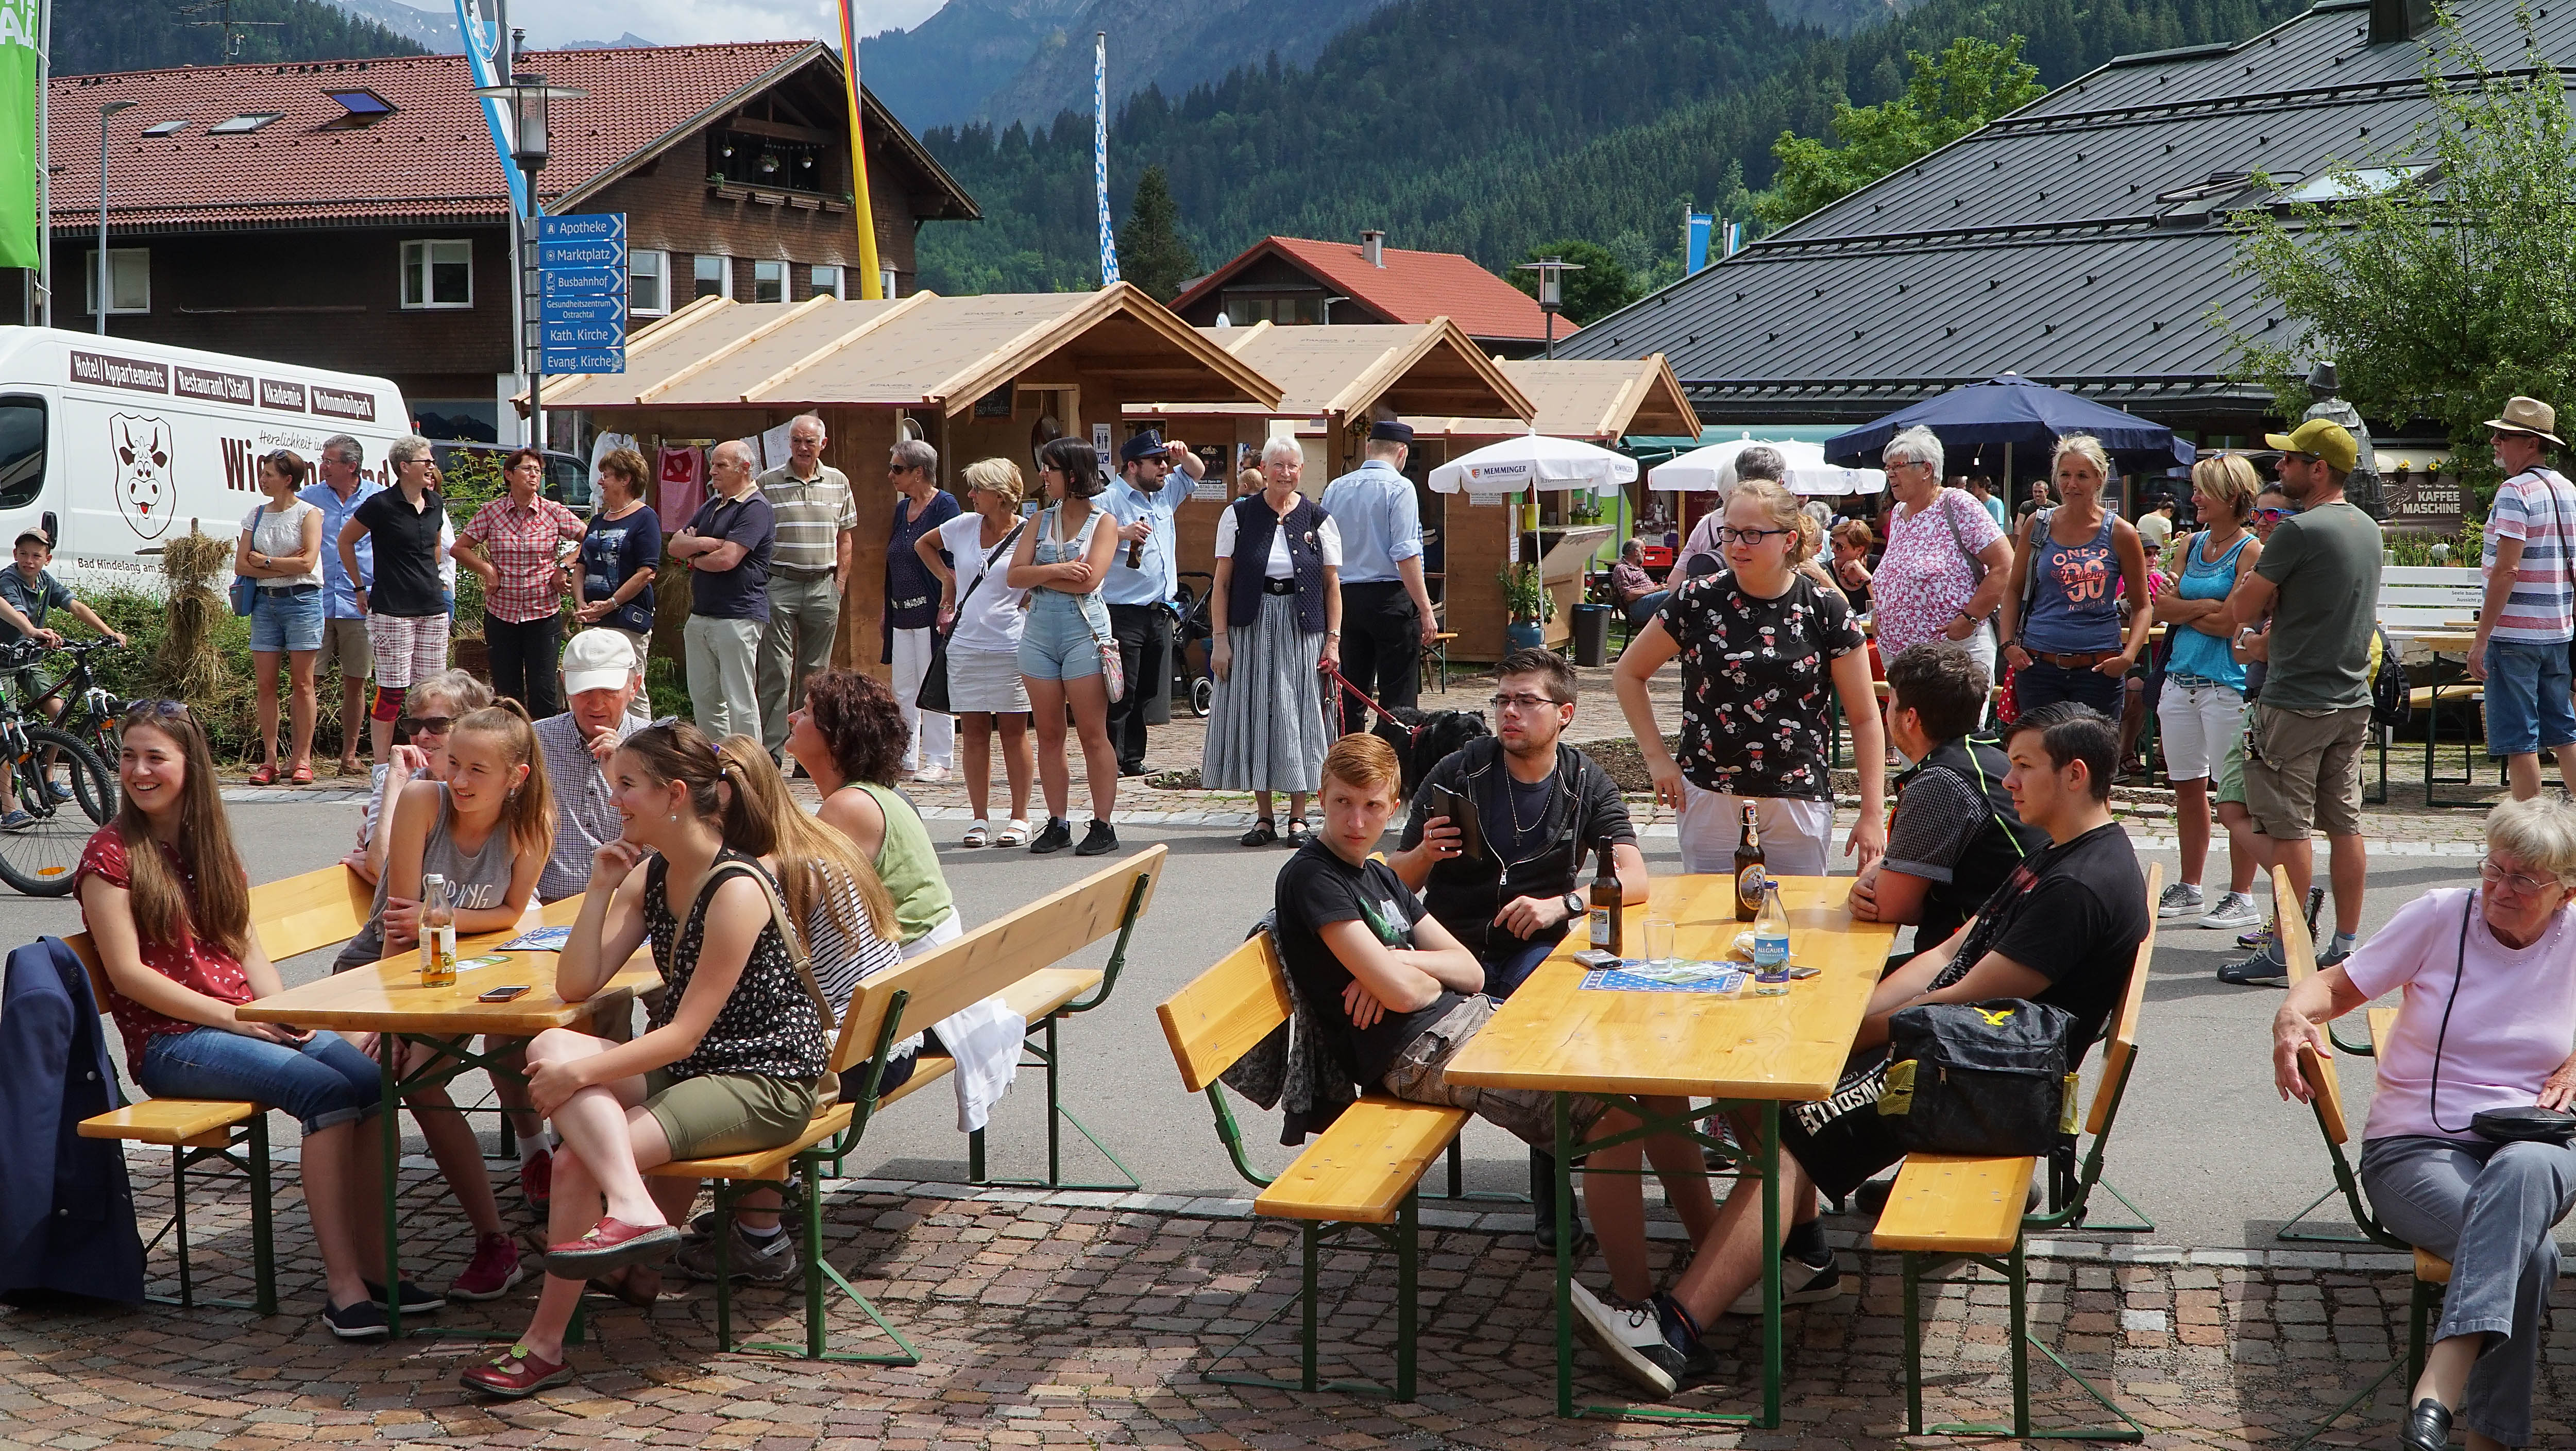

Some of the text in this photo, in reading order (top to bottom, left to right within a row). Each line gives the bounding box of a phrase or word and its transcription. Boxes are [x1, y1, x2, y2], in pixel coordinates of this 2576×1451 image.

[560, 220, 606, 236] Apotheke
[557, 248, 610, 262] Marktplatz
[558, 276, 608, 288] Busbahnhof
[547, 300, 611, 308] Gesundheitszentrum
[563, 310, 595, 318] Ostrachtal
[550, 328, 608, 341] Kath. Kirche
[548, 355, 611, 369] Evang. Kirche
[263, 383, 302, 407] Akademie
[313, 390, 372, 419] Wohnmobilpark
[259, 430, 313, 450] Herzlichkeit
[1484, 466, 1526, 475] MEMMINGER
[2418, 491, 2460, 502] KAFFEE
[2402, 503, 2461, 514] MASCHINE
[78, 558, 95, 569] Bad
[96, 559, 141, 574] Hindelang
[143, 565, 156, 573] am
[1838, 1071, 1859, 1085] LON
[1795, 1073, 1887, 1137] NSDALE
